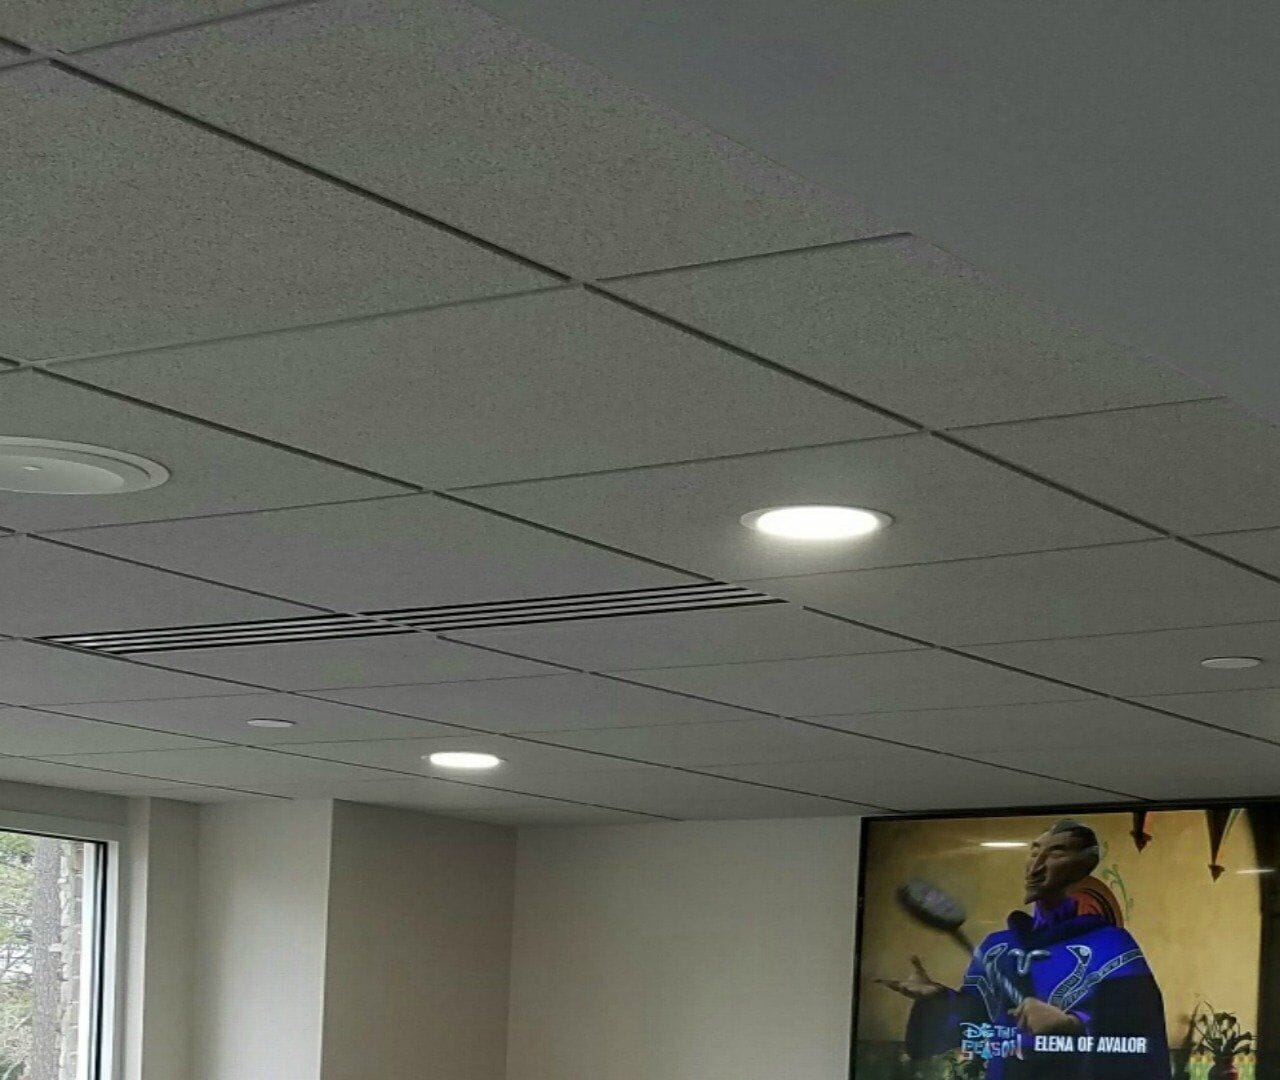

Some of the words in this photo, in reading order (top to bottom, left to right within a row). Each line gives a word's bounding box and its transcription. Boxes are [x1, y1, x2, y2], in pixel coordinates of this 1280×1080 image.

[1035, 1035, 1072, 1052] ELENA
[1077, 1036, 1093, 1052] OF
[1096, 1036, 1147, 1054] AVALOR
